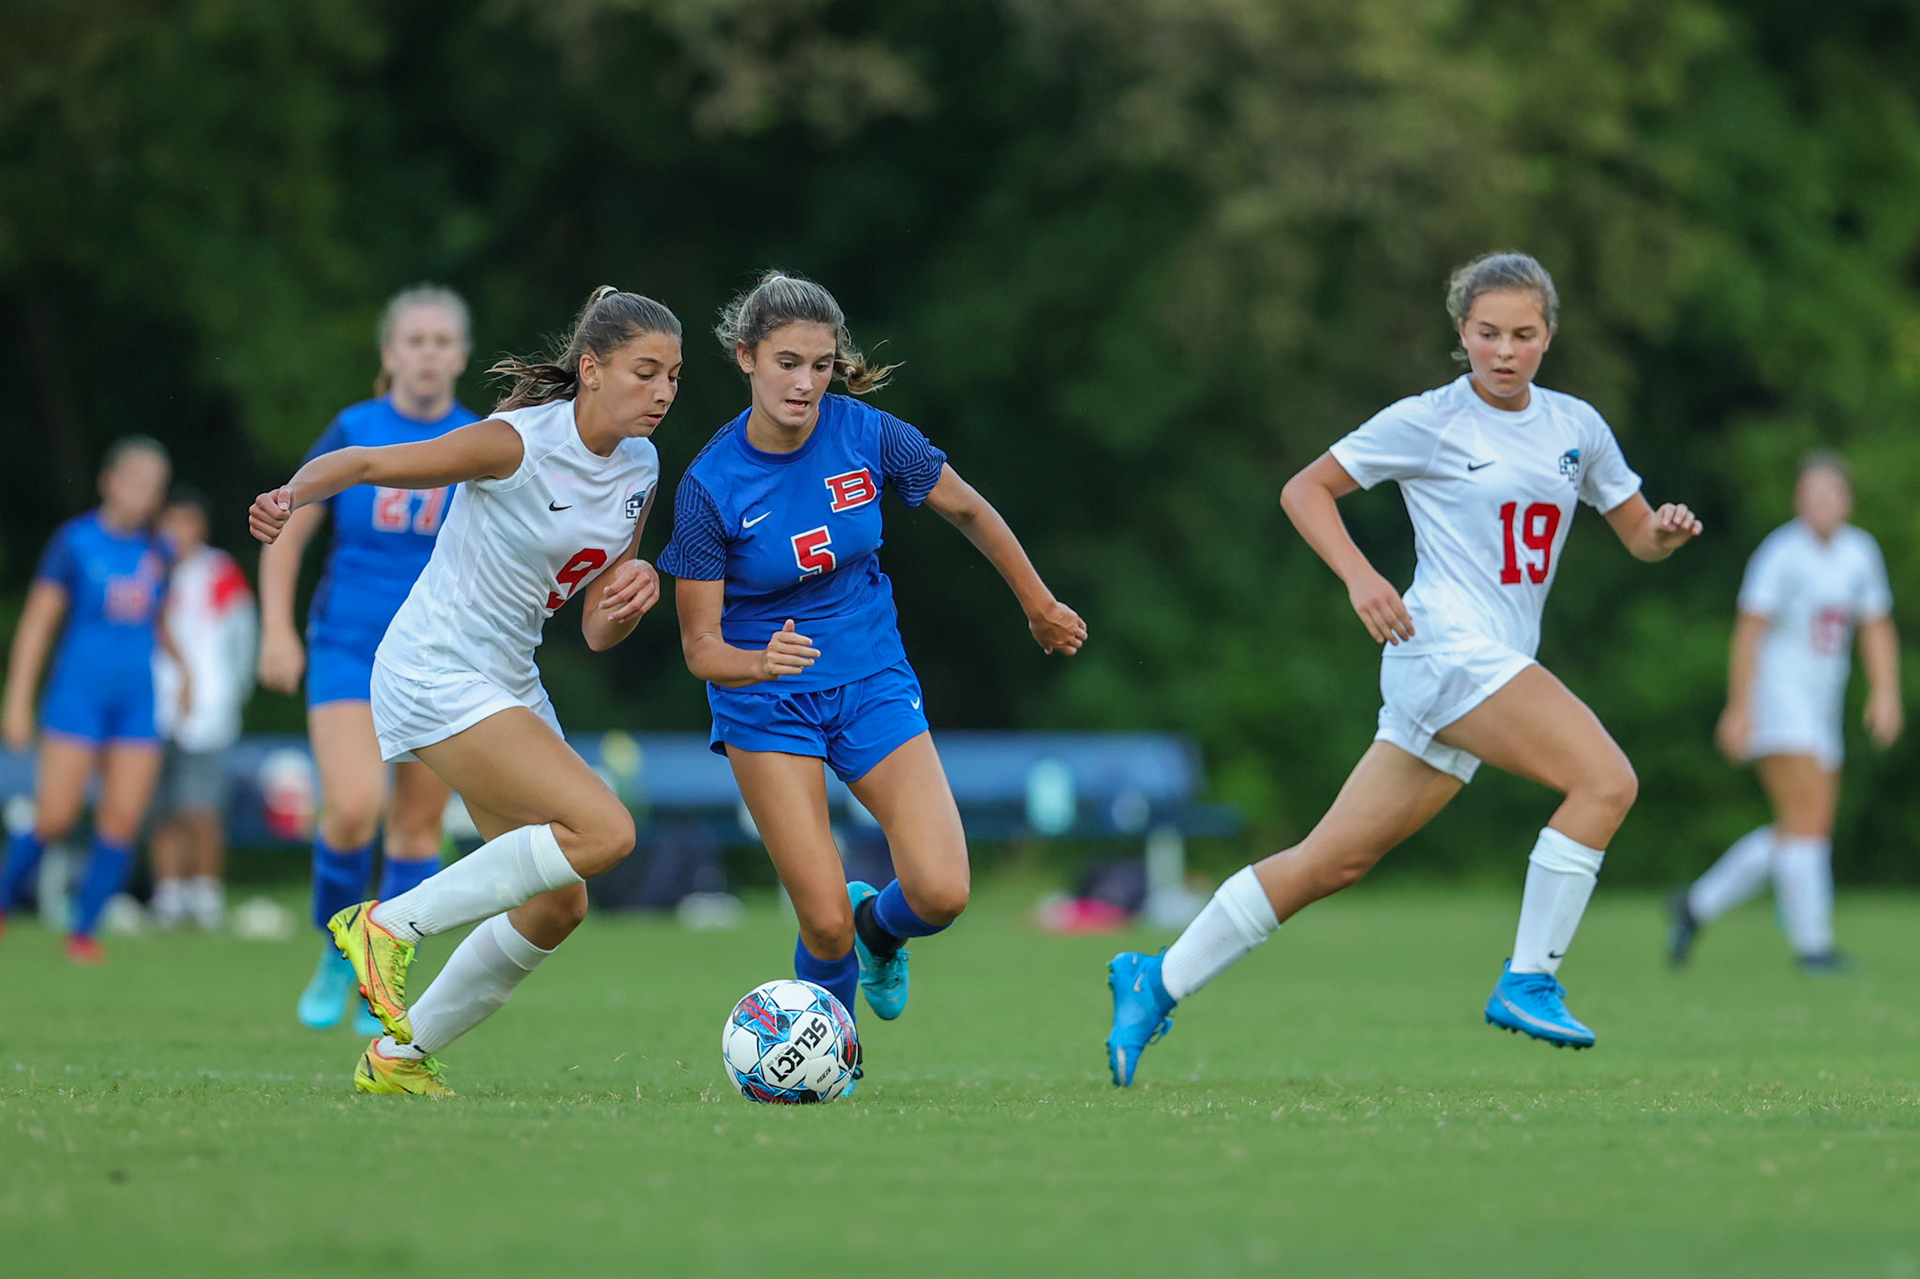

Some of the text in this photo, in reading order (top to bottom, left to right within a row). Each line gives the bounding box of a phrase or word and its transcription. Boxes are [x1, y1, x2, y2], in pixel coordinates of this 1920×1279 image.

[373, 488, 449, 536] 27
[824, 468, 877, 513] B
[790, 525, 836, 582] 5
[1499, 501, 1561, 584] 19
[546, 548, 607, 609] 9
[769, 1017, 828, 1082] SELECT
